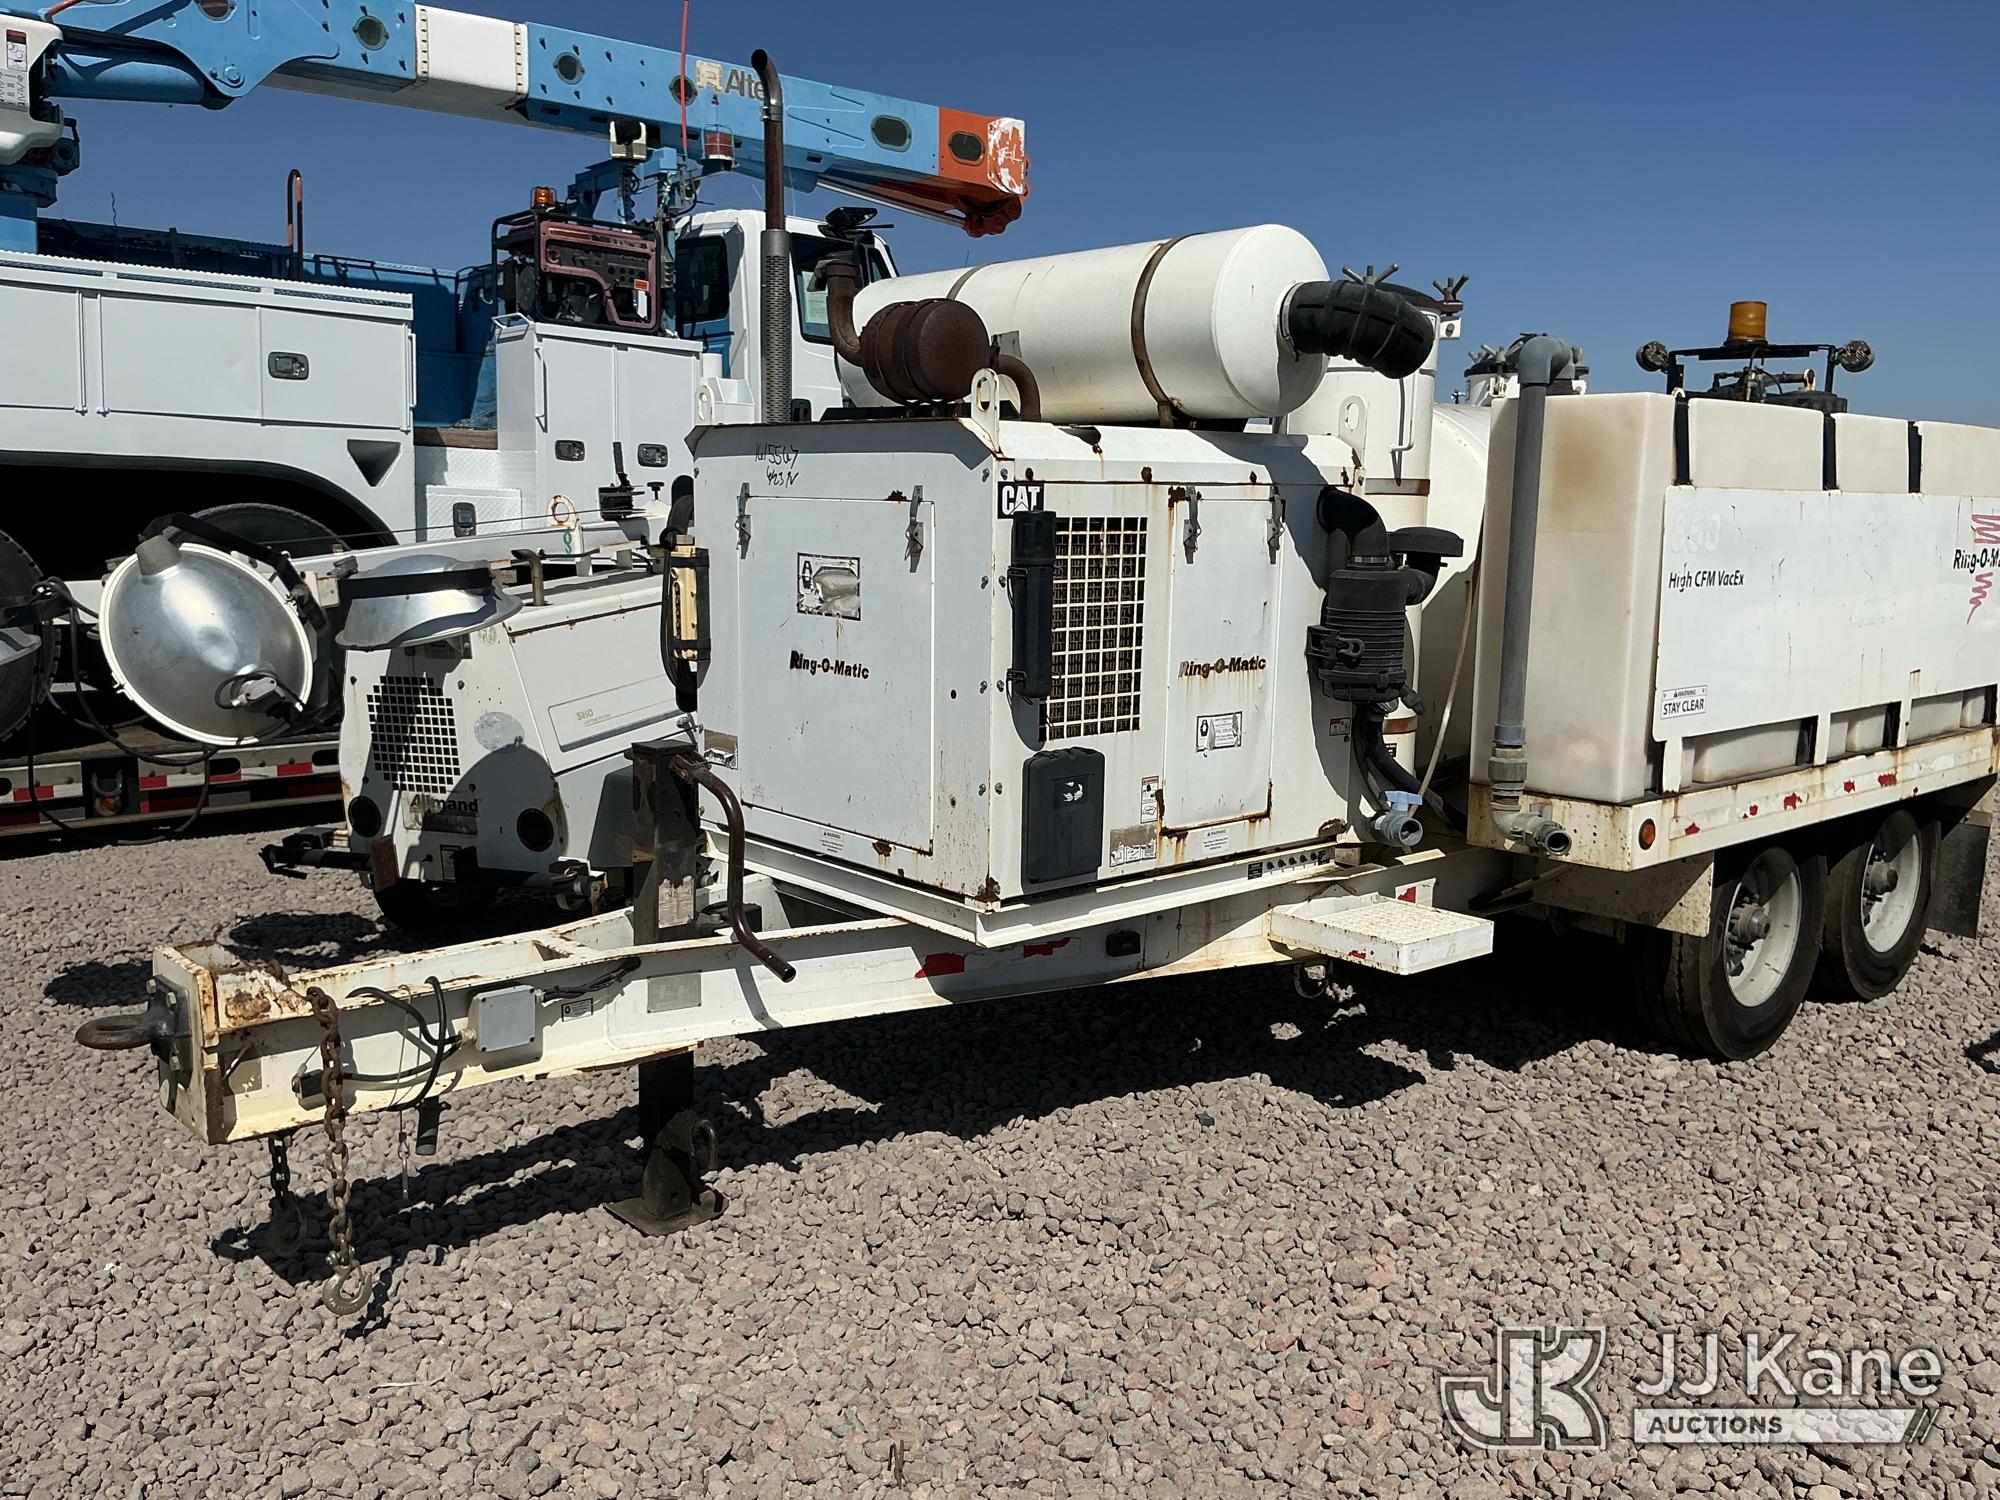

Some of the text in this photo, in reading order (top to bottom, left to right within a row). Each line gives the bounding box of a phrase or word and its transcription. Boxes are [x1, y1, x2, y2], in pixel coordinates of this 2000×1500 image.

[725, 69, 764, 100] Alte
[1002, 485, 1040, 515] CAT
[1953, 548, 2000, 574] Ring-O-M
[1669, 569, 1744, 592] High CFM VacEx
[790, 650, 869, 679] Ring-O-Matic
[1178, 656, 1266, 678] Ring-O-Matic
[1663, 698, 1704, 715] STAY CLEAR
